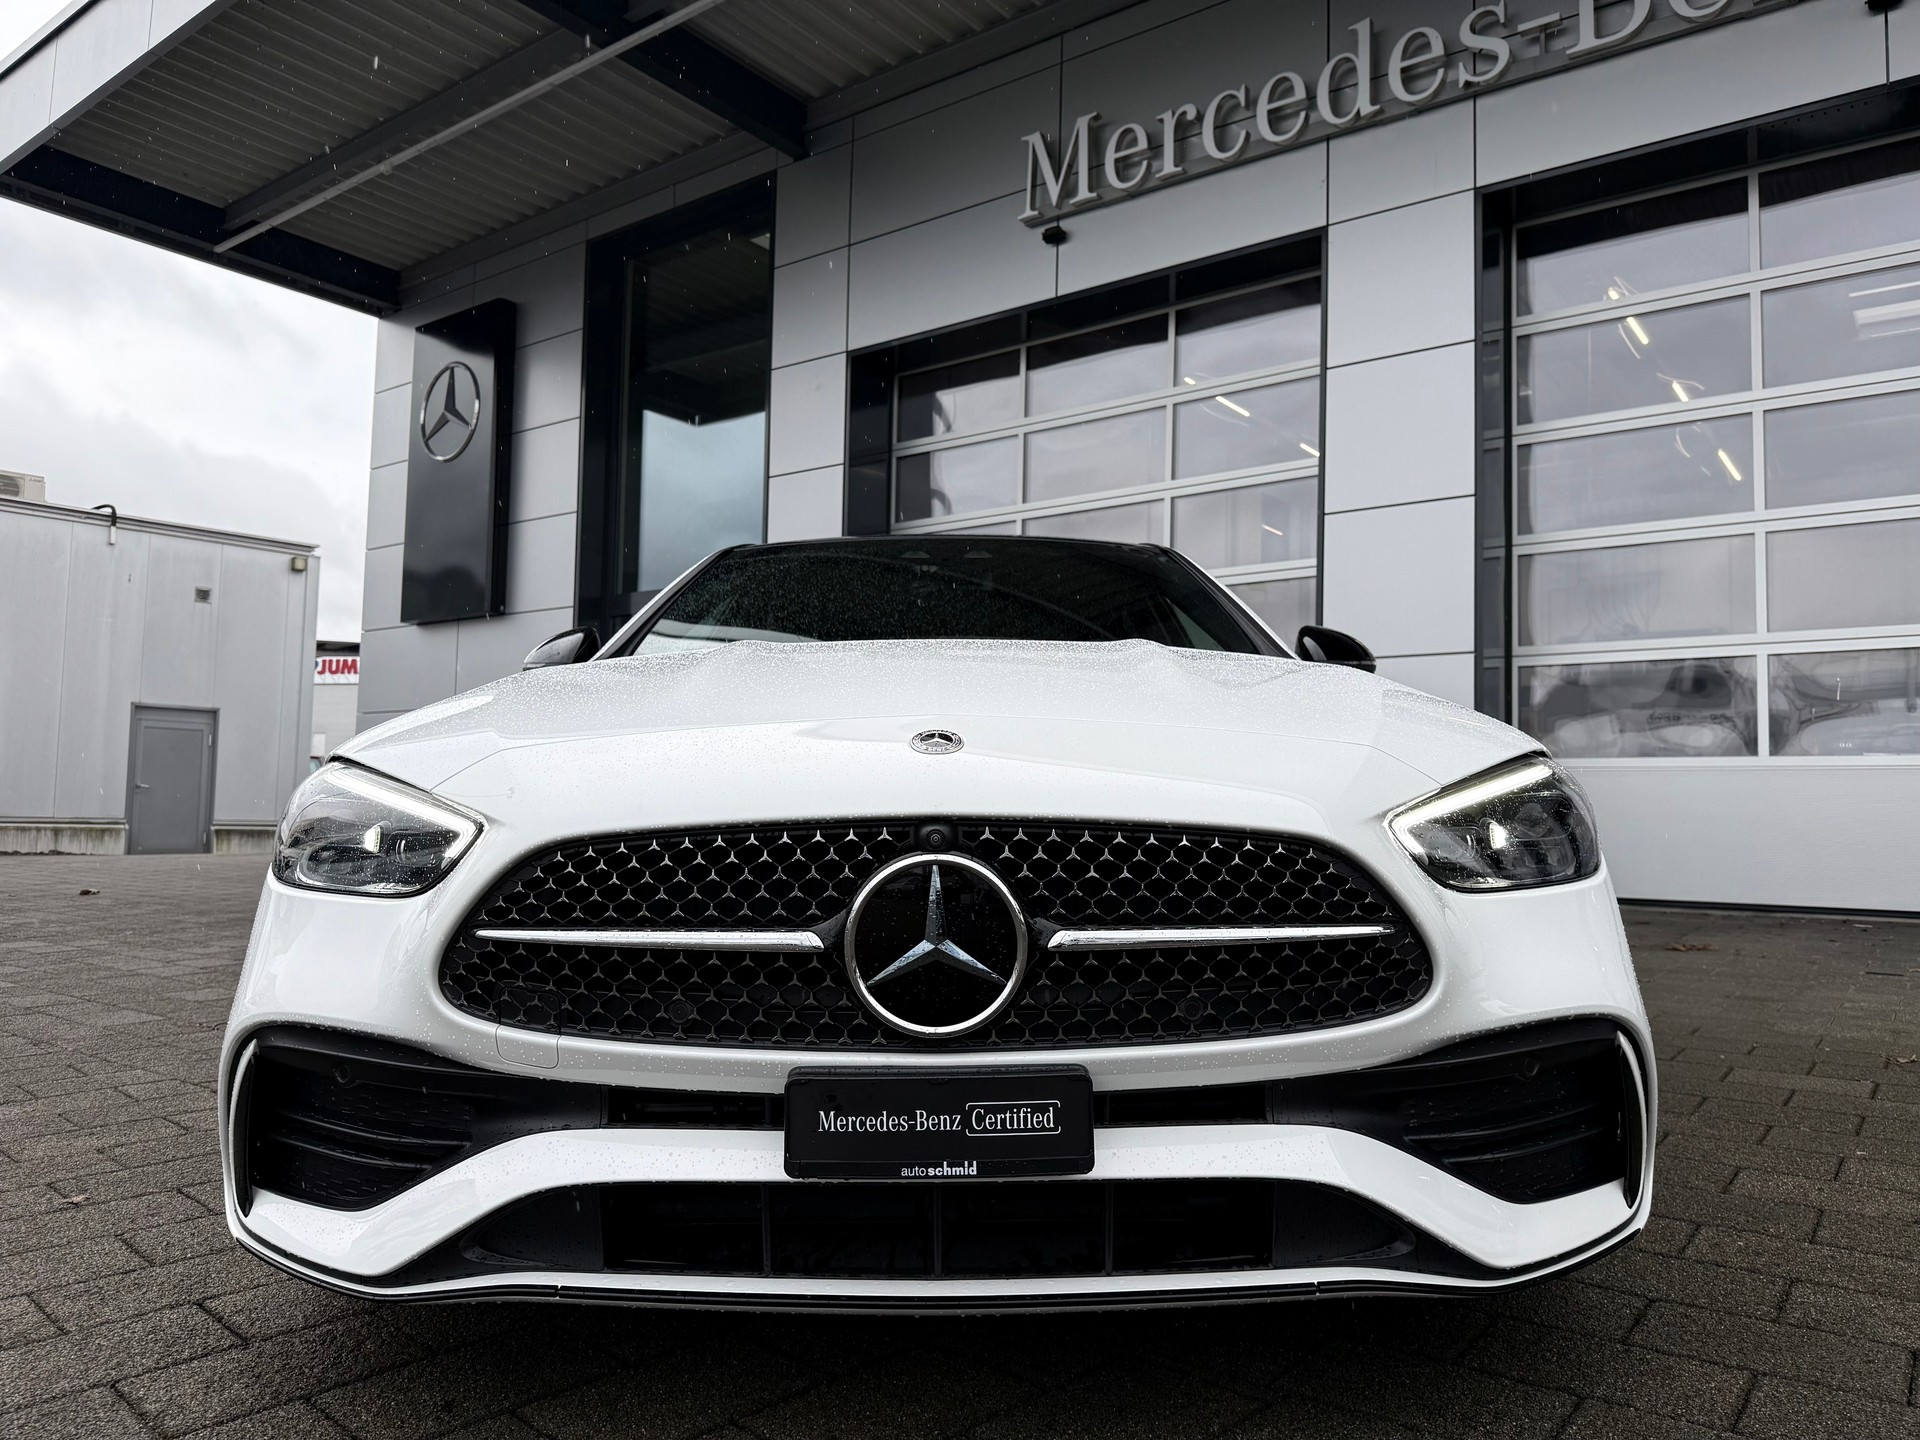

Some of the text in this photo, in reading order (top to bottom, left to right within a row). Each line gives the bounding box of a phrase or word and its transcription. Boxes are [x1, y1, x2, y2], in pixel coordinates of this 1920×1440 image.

[1018, 0, 1730, 222] Mercedes-
[818, 1107, 1055, 1132] Mercedes-Benz Certified
